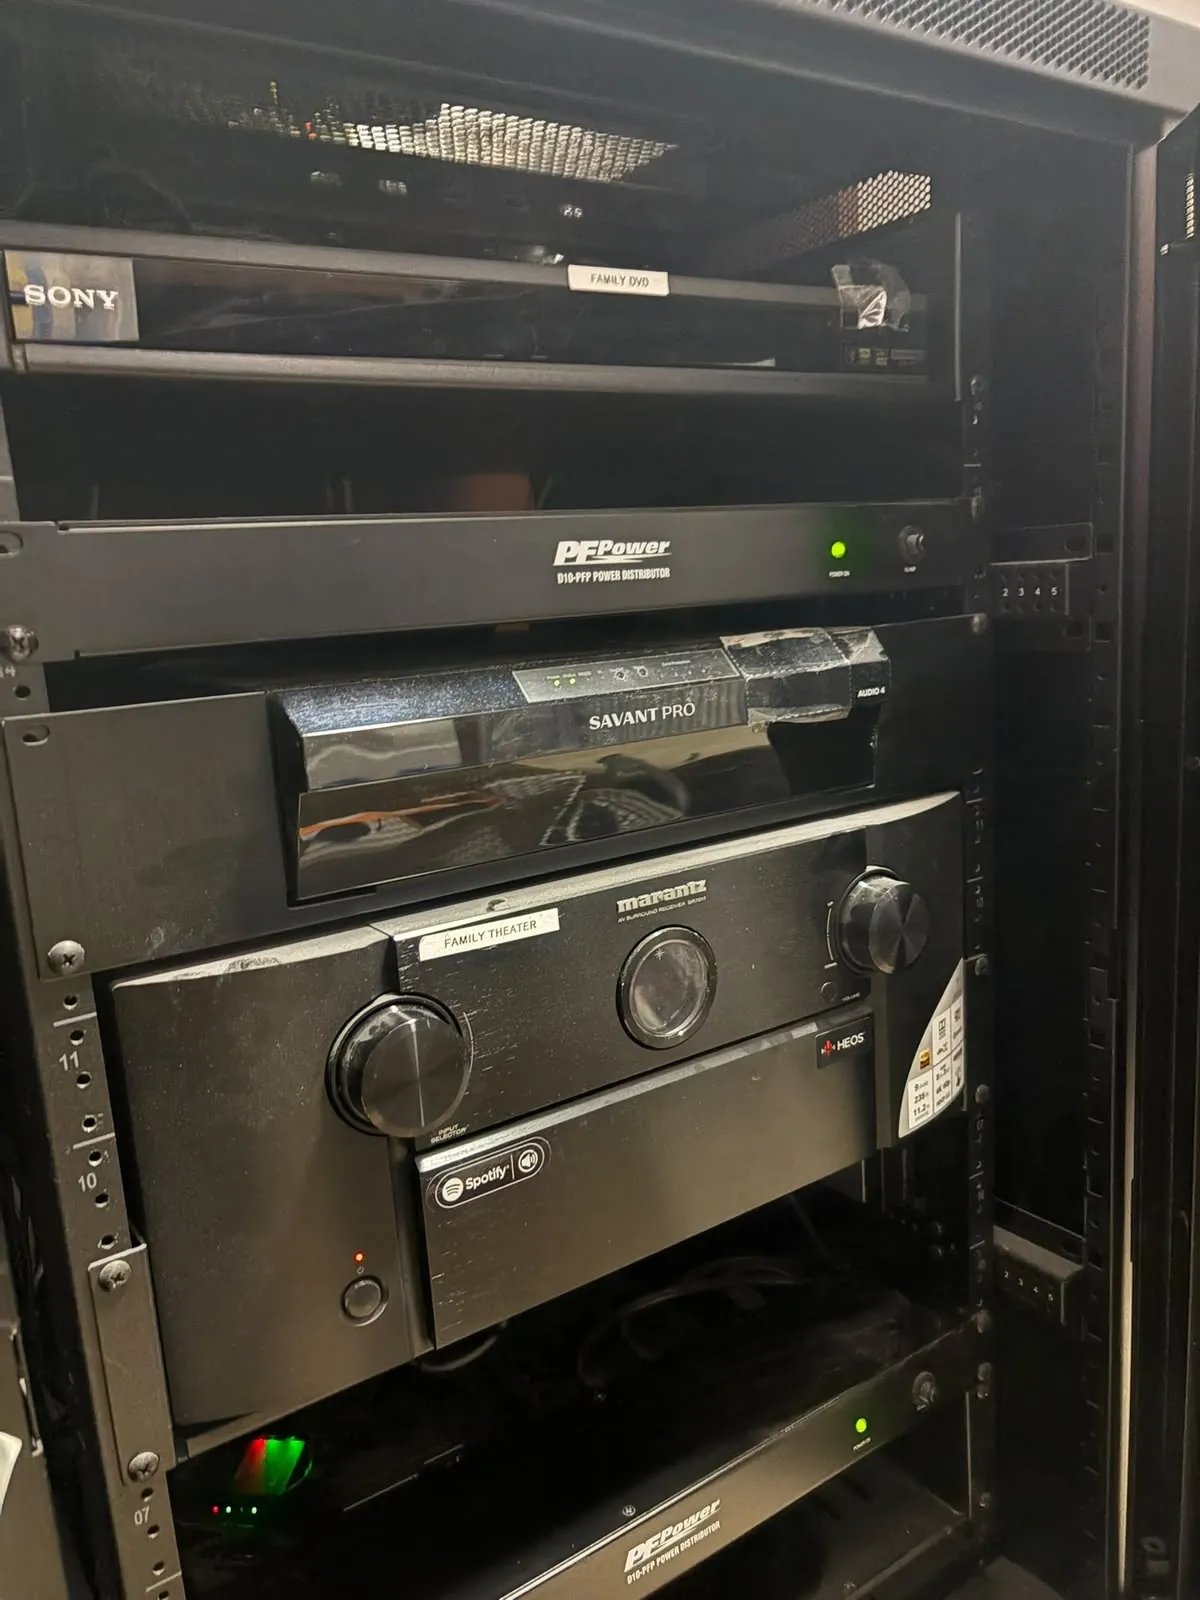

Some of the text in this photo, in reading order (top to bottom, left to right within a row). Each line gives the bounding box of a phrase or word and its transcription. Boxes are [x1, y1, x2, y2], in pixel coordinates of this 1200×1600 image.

[590, 273, 649, 288] FAMILY DVD
[23, 284, 119, 310] SONY
[593, 569, 621, 583] POWER
[622, 567, 671, 581] DISTRIBUTOR
[1001, 586, 1058, 597] 2 3 4 5
[857, 687, 880, 698] AUDIO
[588, 702, 696, 730] SAVANT PRO
[616, 880, 707, 913] marantz
[444, 920, 537, 949] FAMILY THEATER
[837, 1032, 865, 1051] HEOS
[59, 1051, 79, 1071] 11
[430, 1127, 467, 1144] SELECTOR
[438, 1123, 459, 1135] INPUT
[78, 1172, 97, 1192] 10
[465, 1165, 507, 1190] Spotify
[134, 1505, 150, 1525] 07
[656, 1546, 680, 1567] POWER
[680, 1520, 721, 1552] DISTRIBUTOR
